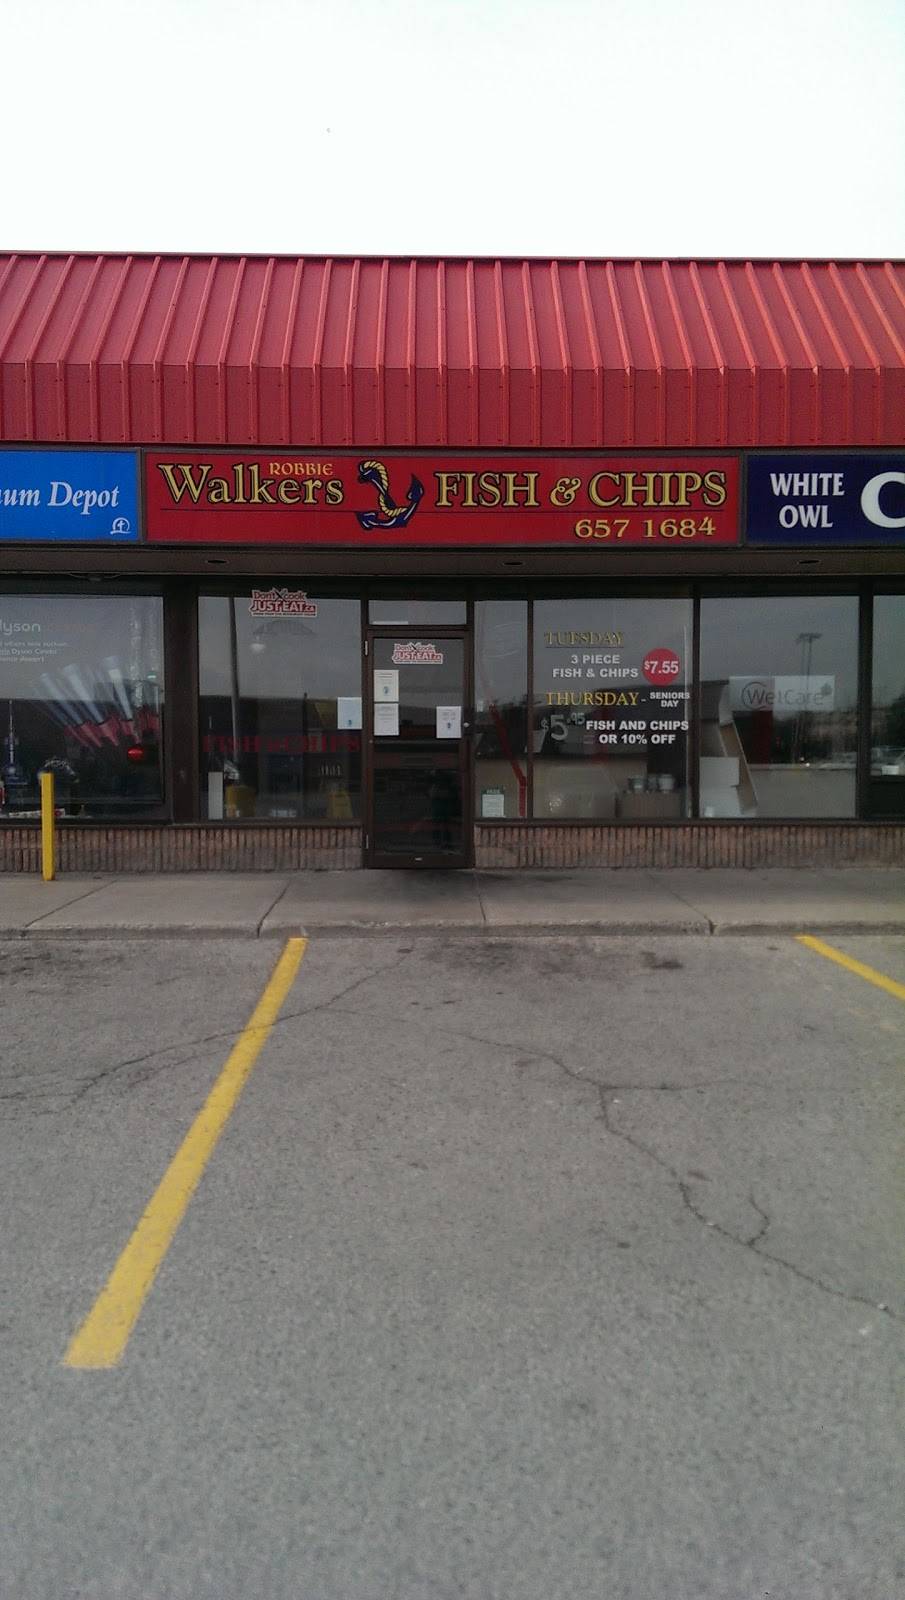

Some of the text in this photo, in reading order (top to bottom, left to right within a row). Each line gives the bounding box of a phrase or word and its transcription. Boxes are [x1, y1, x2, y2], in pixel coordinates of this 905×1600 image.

[269, 462, 333, 476] ROBBIE
[158, 462, 345, 506] Walkers
[434, 470, 728, 508] FISH & CHIPS
[769, 472, 845, 498] WHITE
[0, 481, 120, 515] um Depot
[779, 504, 833, 529] OWL
[574, 516, 716, 539] 657 1684
[544, 631, 625, 646] TUESDAY
[571, 654, 621, 664] 3 PIECE
[552, 667, 640, 678] FISH & CHIPS
[644, 660, 680, 675] $7.55
[545, 691, 640, 706] THURSDAY
[649, 691, 691, 700] SENIORS
[660, 700, 680, 708] DAY
[586, 720, 690, 731] FISH AND CHIPS
[598, 734, 677, 745] OR 10% OFF
